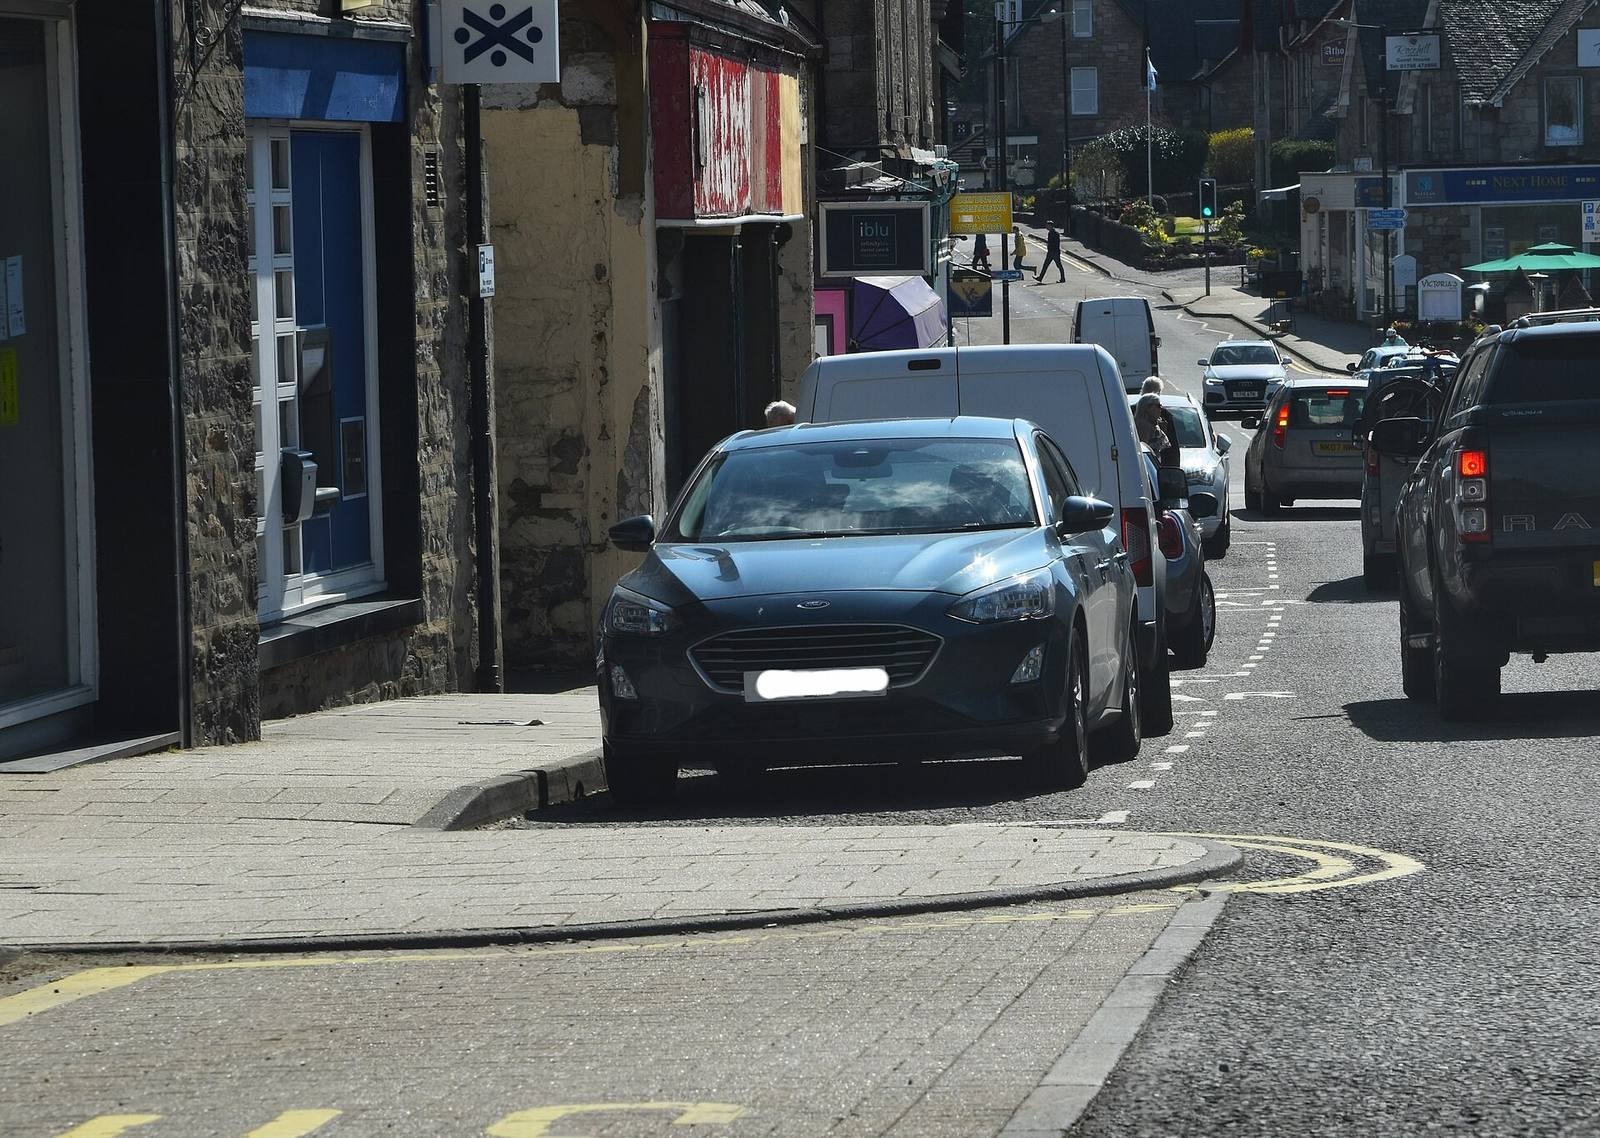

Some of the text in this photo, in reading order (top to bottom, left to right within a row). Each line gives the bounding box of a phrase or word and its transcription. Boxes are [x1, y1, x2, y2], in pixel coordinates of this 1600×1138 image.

[1492, 175, 1568, 187] NEXT HOME
[860, 221, 889, 237] iblu
